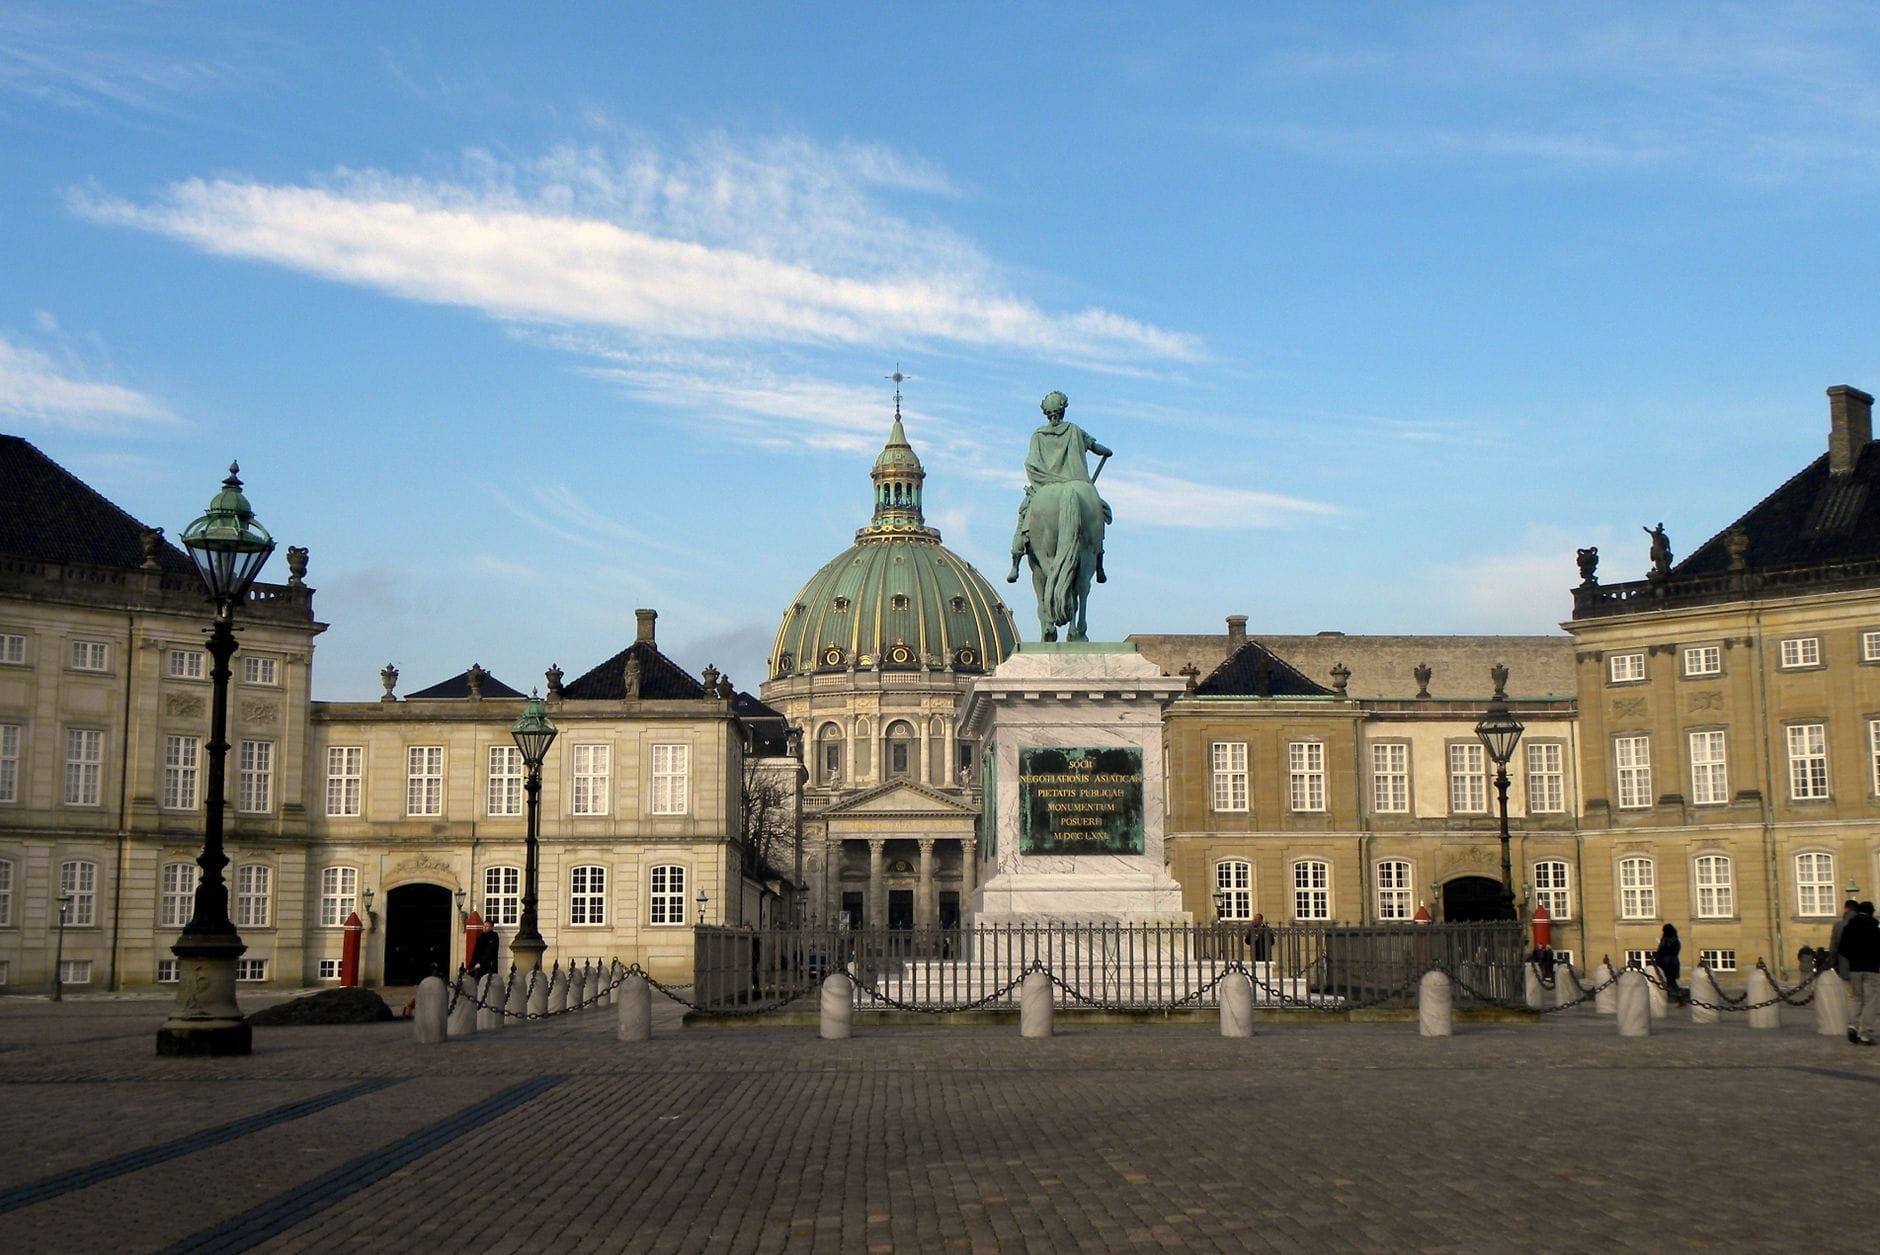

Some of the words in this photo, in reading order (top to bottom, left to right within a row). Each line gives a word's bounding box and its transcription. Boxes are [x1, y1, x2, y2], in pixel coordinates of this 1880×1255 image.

[1020, 774, 1090, 783] NEGOTIATIONIS
[1038, 789, 1076, 798] PIETATIS
[1047, 803, 1115, 812] MONUMENTUM
